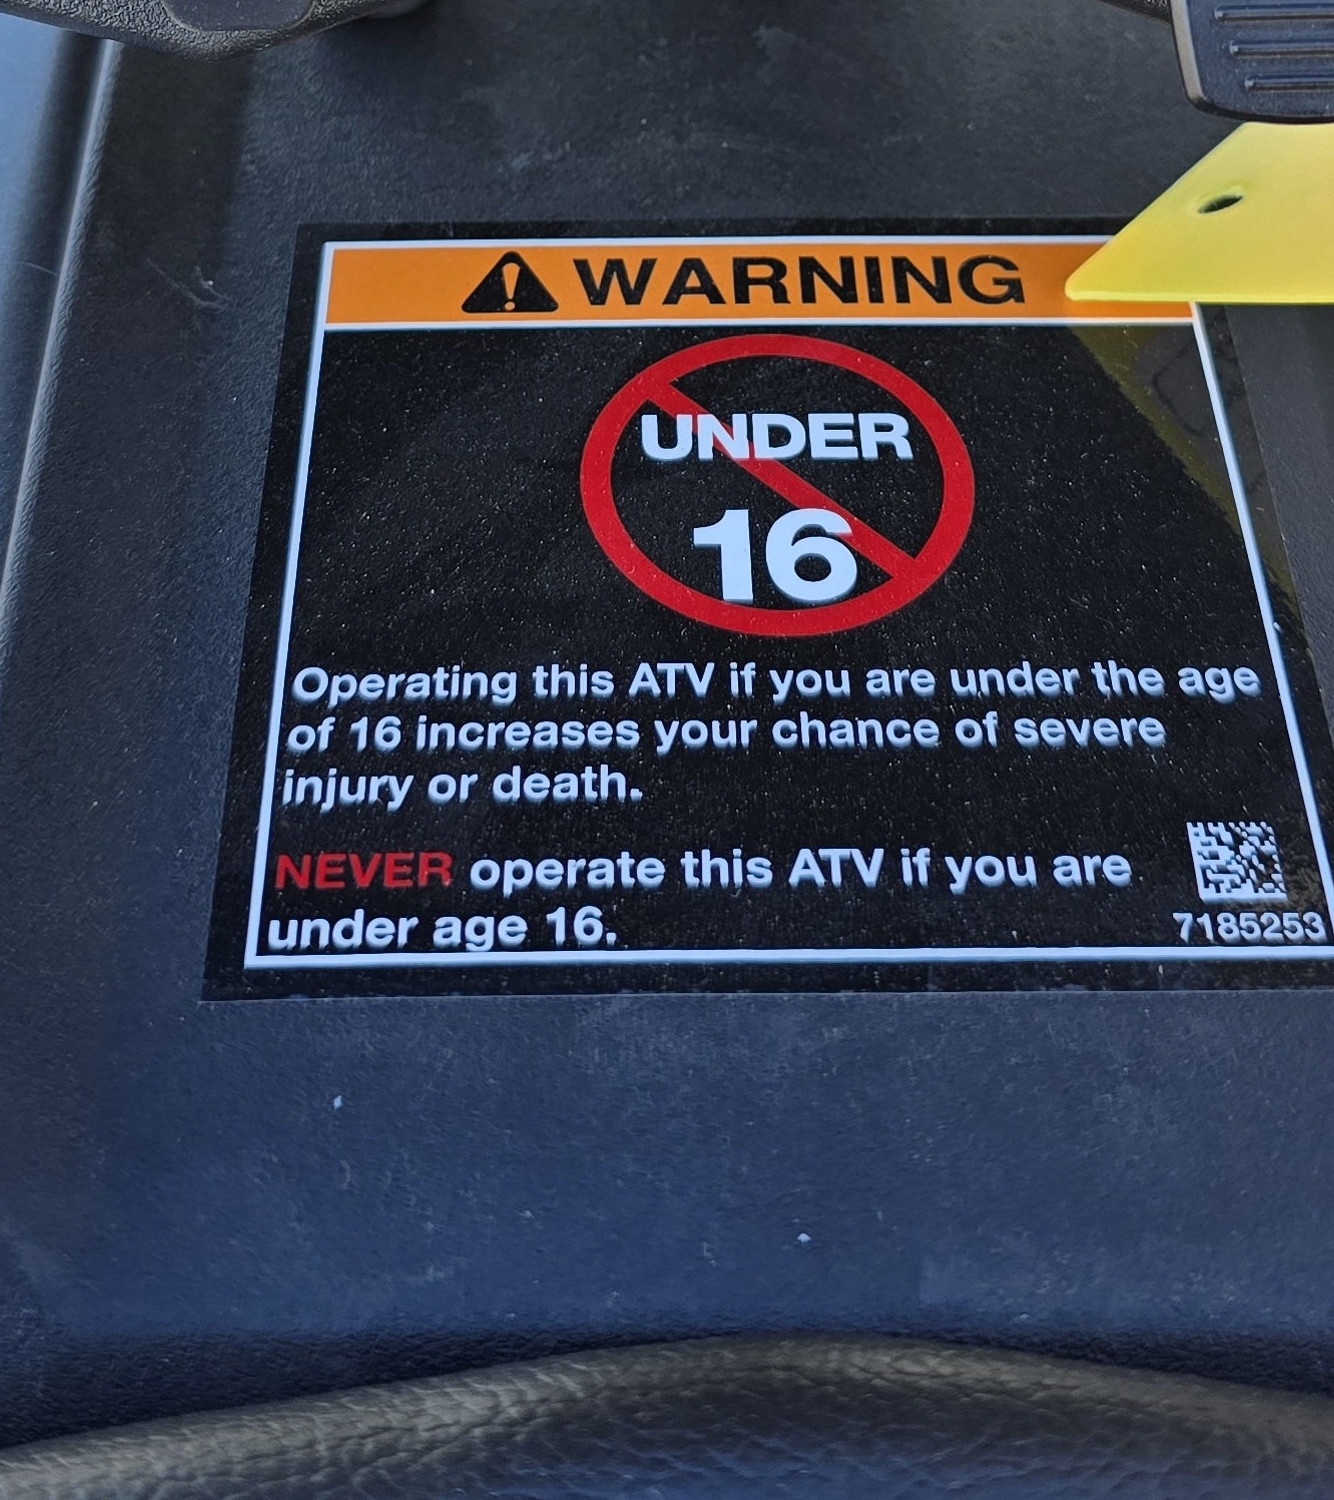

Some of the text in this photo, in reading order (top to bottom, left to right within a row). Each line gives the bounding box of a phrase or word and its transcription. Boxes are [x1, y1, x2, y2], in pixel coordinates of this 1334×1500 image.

[571, 255, 1027, 308] WARNING
[639, 412, 915, 462] UNDER
[690, 507, 860, 604] 16
[292, 659, 1261, 707] Operating this ATV if you are under the age
[287, 709, 1167, 757] of 16 increases your chance of severe
[282, 764, 644, 813] injury or death.
[274, 846, 1133, 897] NEVER operate this ATV if you are
[267, 905, 618, 953] under age 16.
[1172, 911, 1327, 944] 7185253
